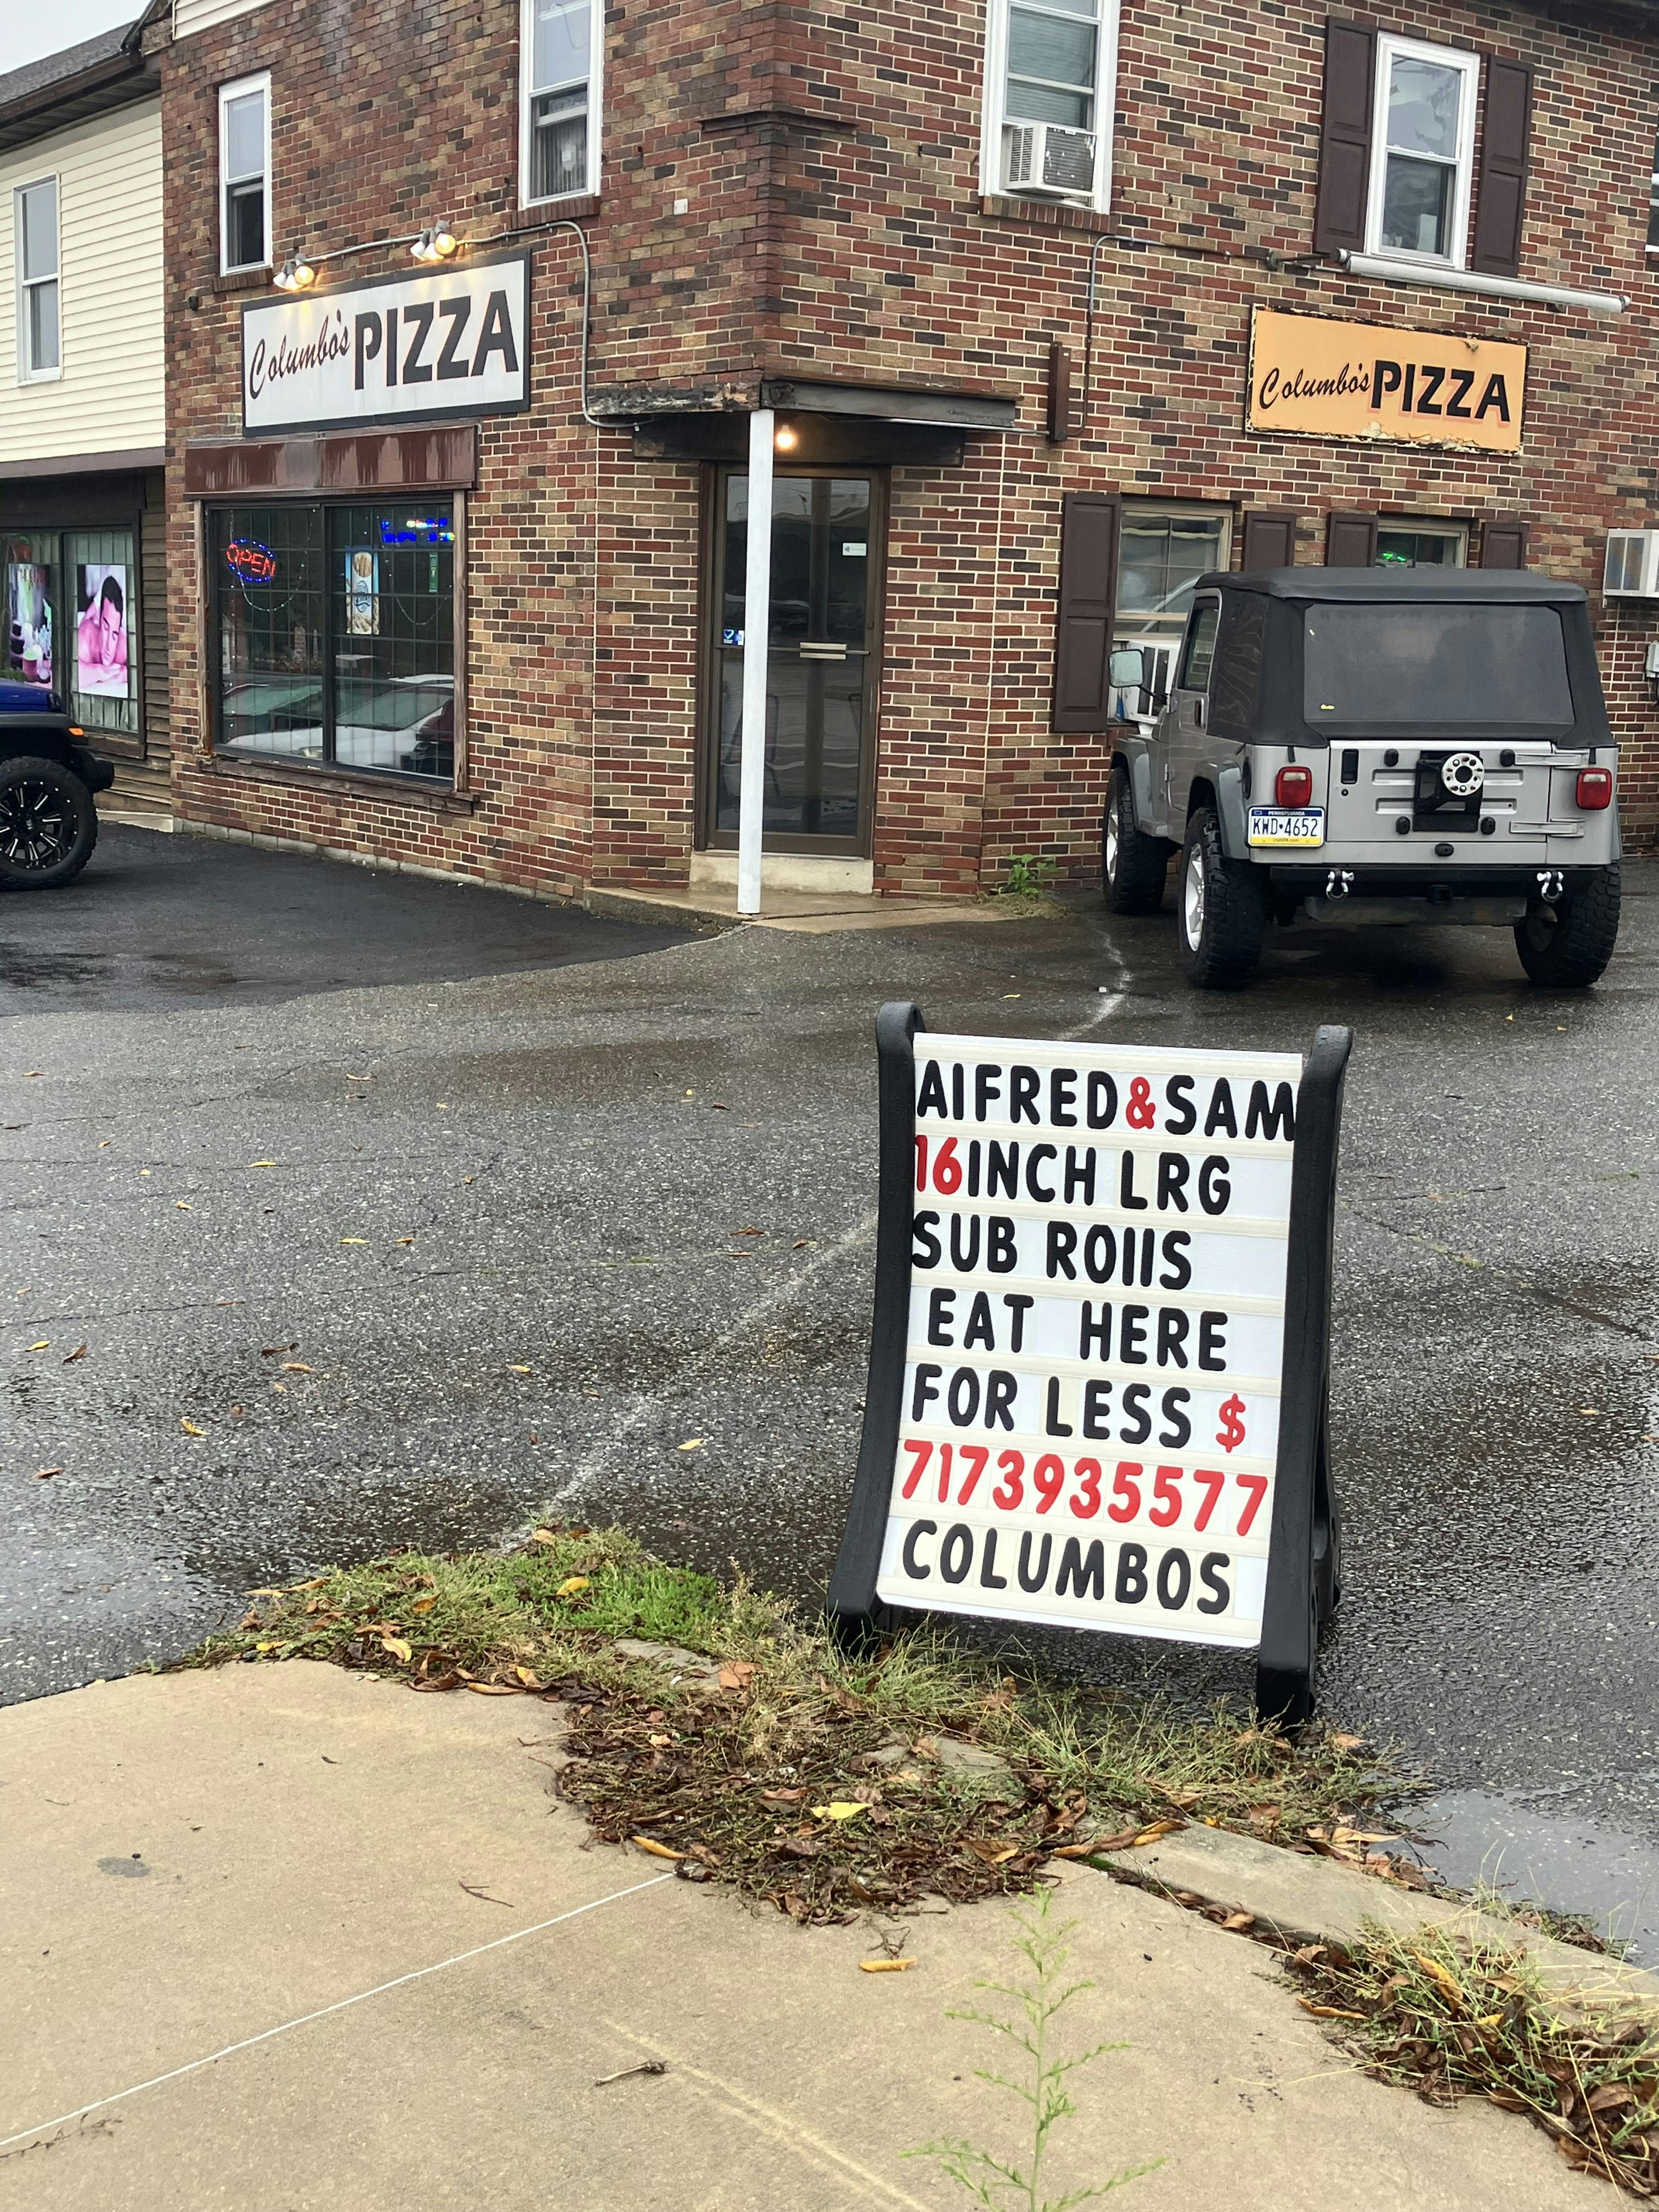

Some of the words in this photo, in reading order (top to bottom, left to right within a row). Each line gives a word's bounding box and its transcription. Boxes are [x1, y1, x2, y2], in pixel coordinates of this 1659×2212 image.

[250, 309, 350, 399] Columbo's
[354, 289, 519, 391] PIZZA
[1259, 363, 1370, 409] Columbo's
[1371, 359, 1510, 422] PIZZA
[226, 544, 276, 577] OPEN
[1121, 1150, 1231, 1215] LRG
[912, 1211, 1018, 1273] SUB
[928, 1288, 1034, 1353] EAT
[1080, 1301, 1228, 1372] HERE
[912, 1363, 1018, 1431] FOR
[1046, 1376, 1192, 1448] LESS
[1216, 1393, 1246, 1453] $
[902, 1440, 1268, 1536] 7173935577
[902, 1520, 1230, 1615] COLUMBOS
